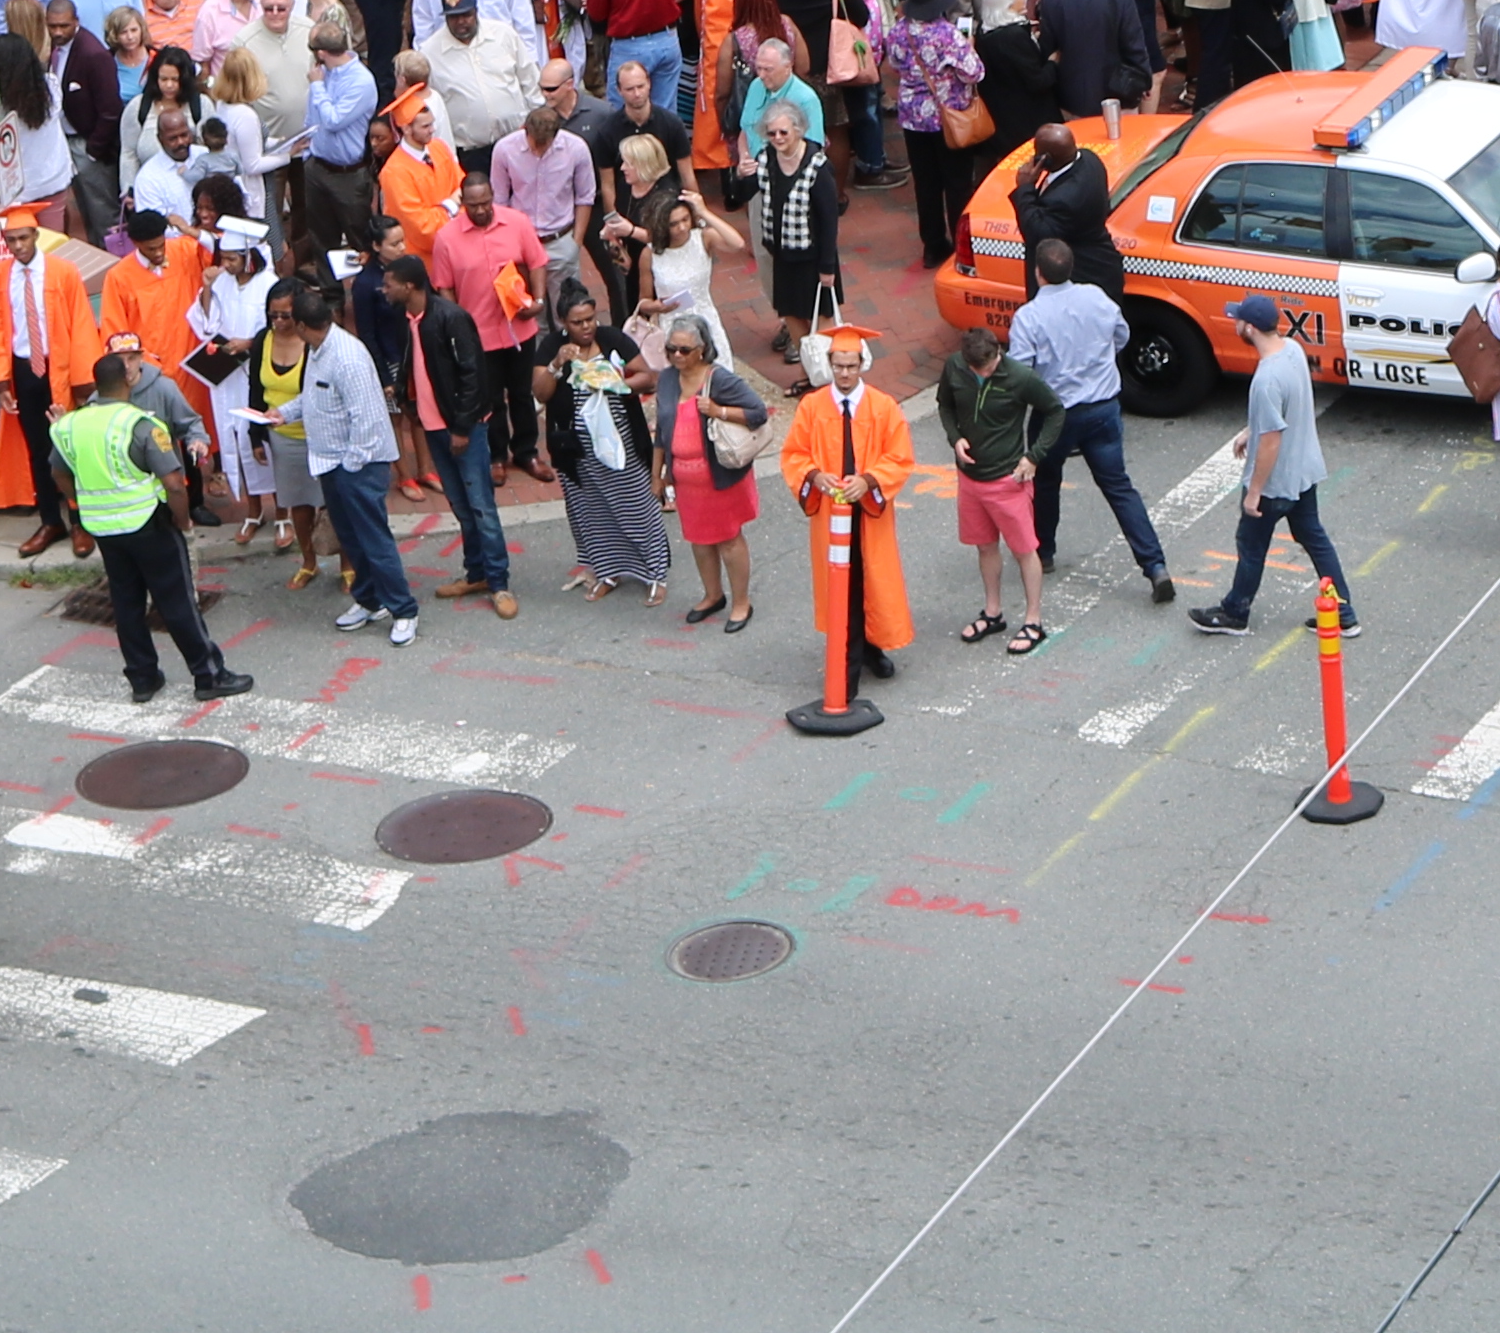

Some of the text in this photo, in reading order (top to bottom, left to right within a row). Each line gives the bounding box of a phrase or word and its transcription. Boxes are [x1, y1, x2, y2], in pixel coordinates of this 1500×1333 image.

[983, 220, 1011, 234] THIS
[964, 291, 1024, 312] Emergen
[1346, 293, 1376, 308] VCU
[1280, 307, 1326, 347] XI
[1346, 310, 1463, 341] POLI
[1332, 357, 1363, 379] OR
[1373, 360, 1430, 387] LOSE
